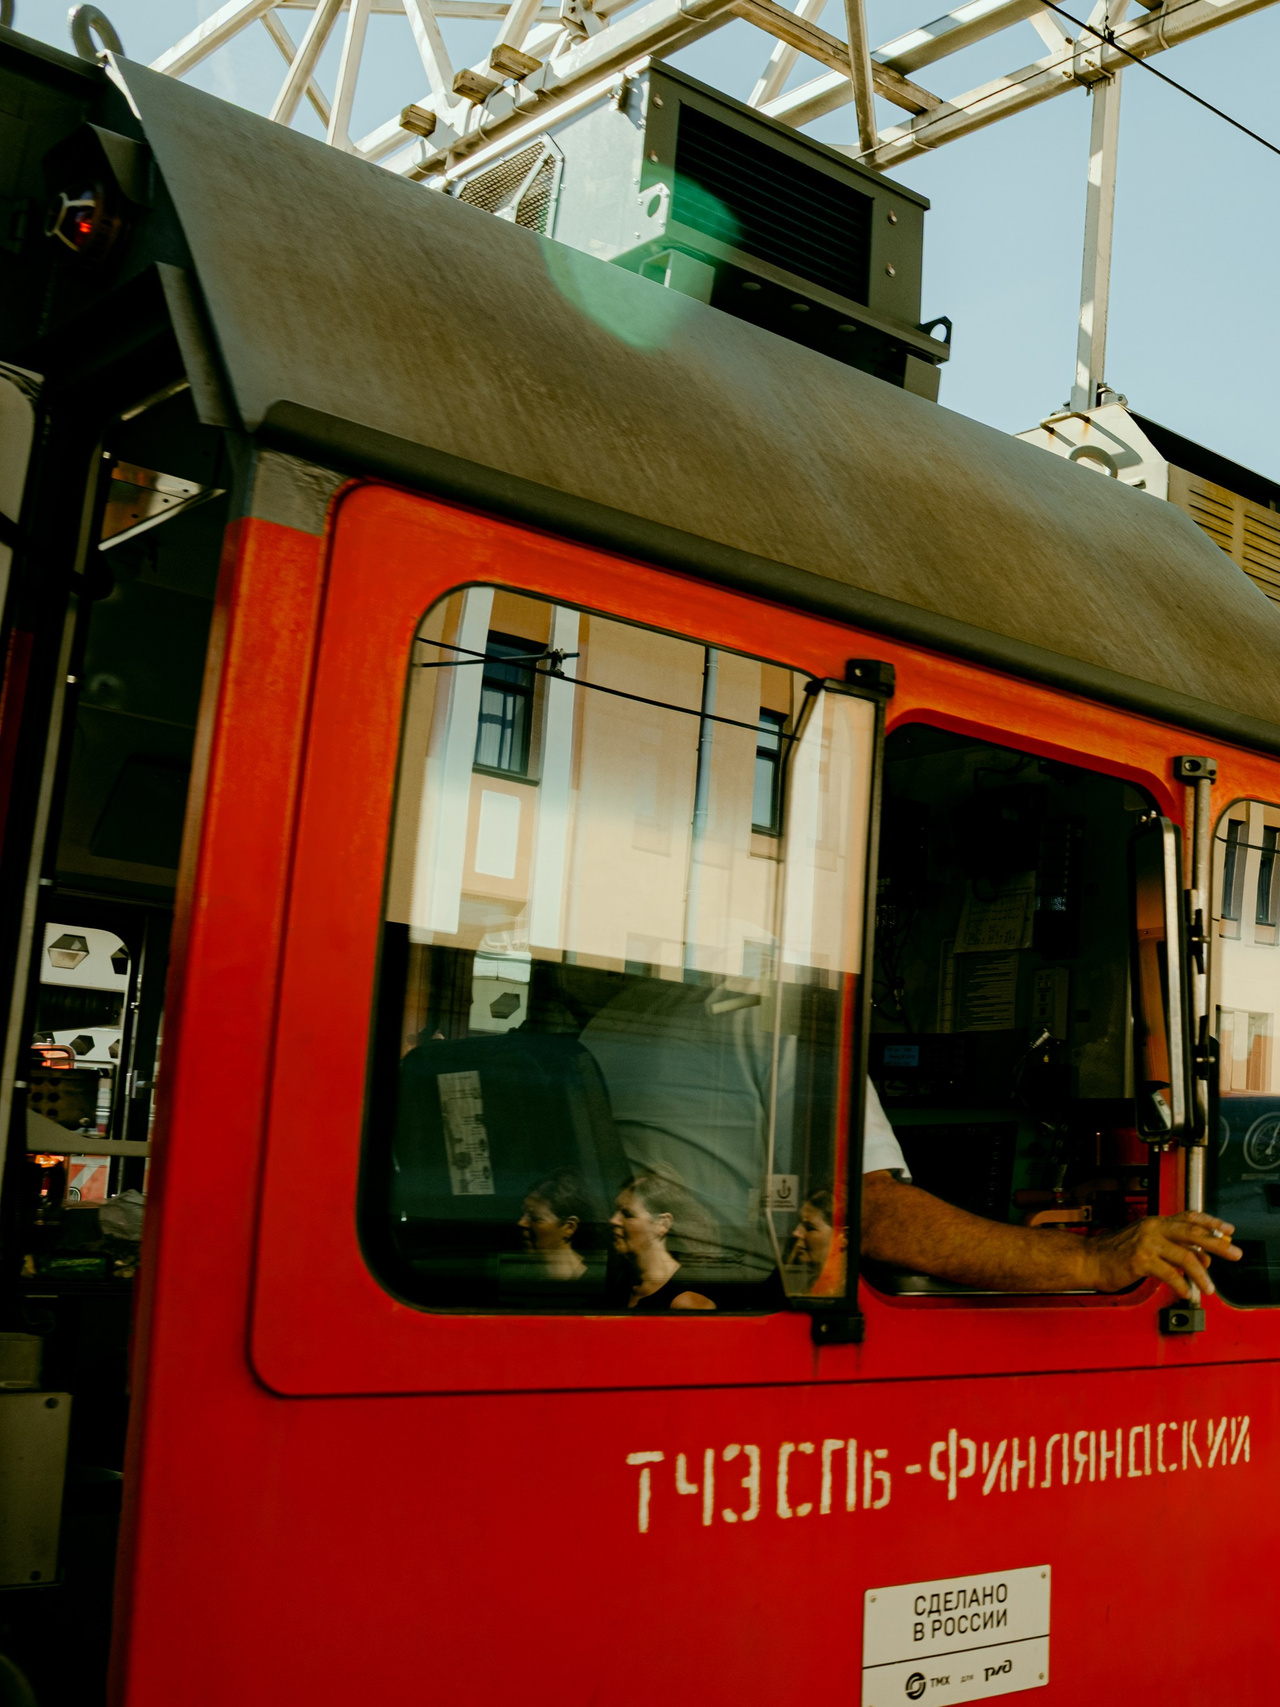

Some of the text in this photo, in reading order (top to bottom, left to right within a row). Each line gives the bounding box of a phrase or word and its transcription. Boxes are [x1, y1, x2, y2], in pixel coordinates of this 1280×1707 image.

[913, 1583, 1008, 1618] СДЕЛАНО
[913, 1608, 1008, 1642] В РОССИИ
[930, 1675, 951, 1688] ТМХ
